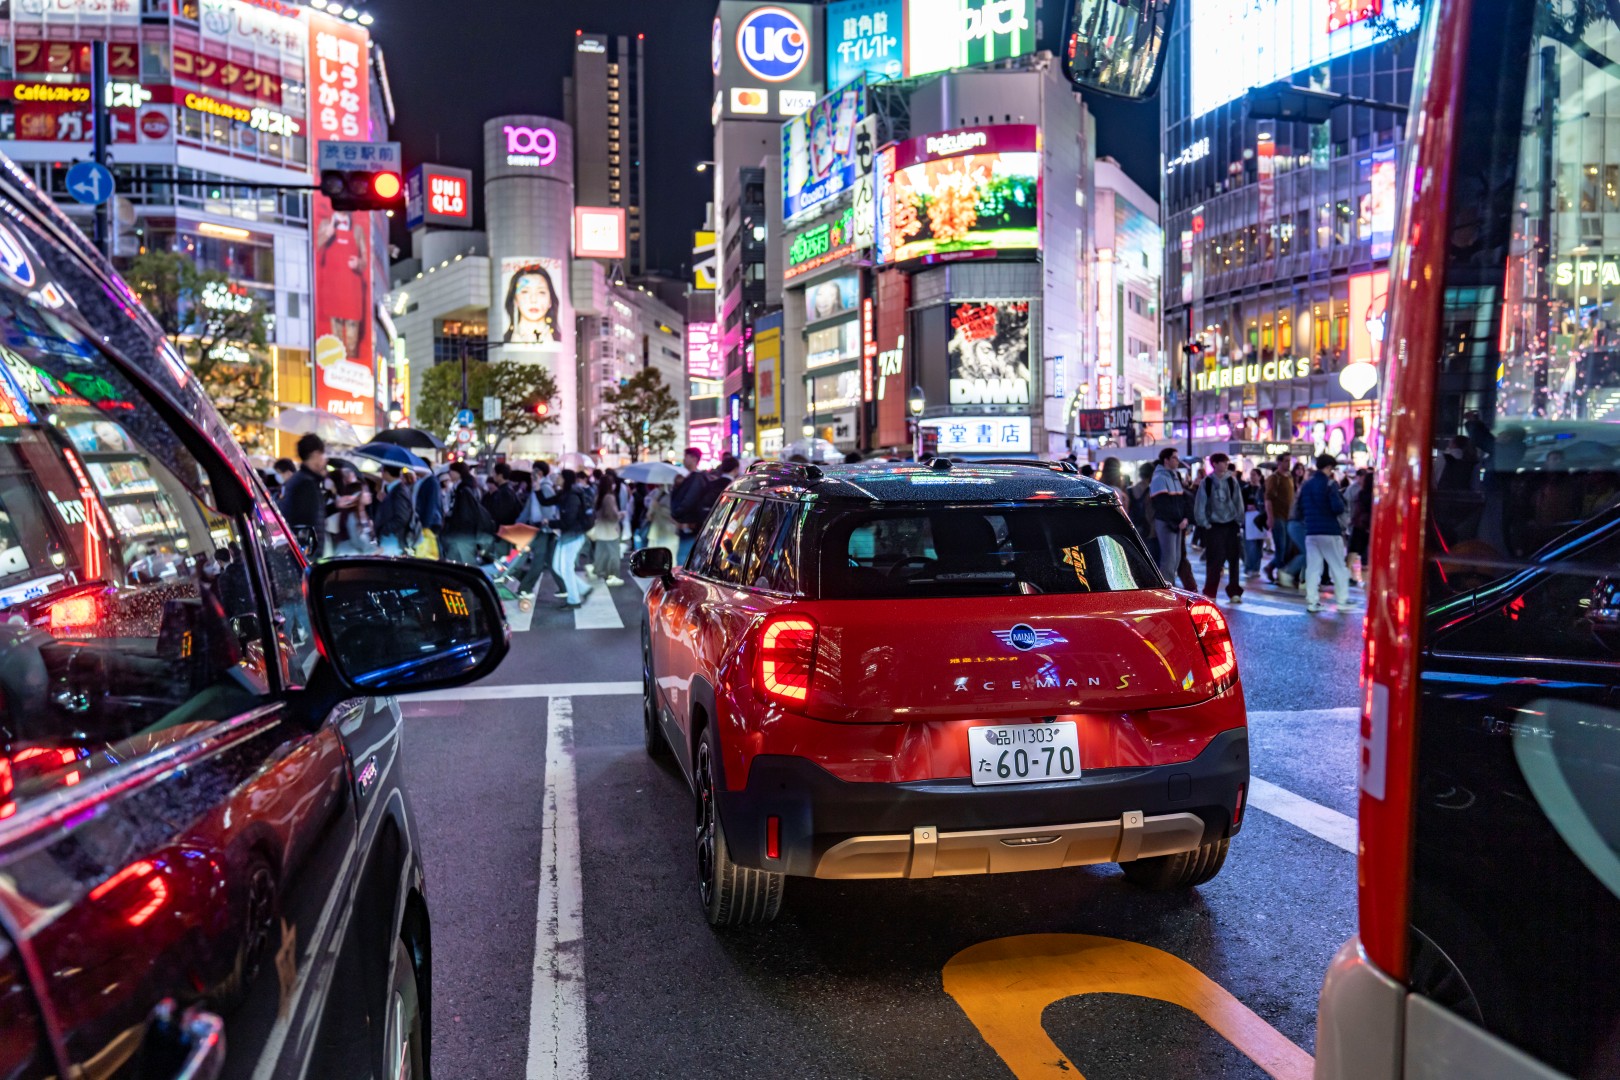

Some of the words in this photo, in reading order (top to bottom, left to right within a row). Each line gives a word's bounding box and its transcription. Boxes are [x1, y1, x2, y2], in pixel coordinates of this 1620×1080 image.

[744, 26, 803, 64] UC
[173, 49, 279, 97] コンタクト
[105, 81, 152, 108] スト
[784, 97, 814, 108] VISA
[324, 144, 394, 162] 渋谷駅前
[503, 125, 557, 166] 109
[926, 131, 987, 154] Rakuten
[431, 177, 462, 198] UNI
[431, 194, 464, 214] QLO
[949, 378, 1030, 404] DMM
[937, 424, 1020, 444] 堂書店
[1013, 632, 1033, 642] MINI
[955, 677, 1100, 692] ACEMAN
[1116, 674, 1130, 690] S
[996, 729, 1026, 746] 品川
[1027, 727, 1054, 744] 303
[978, 758, 992, 772] た
[997, 746, 1075, 778] 60-70
